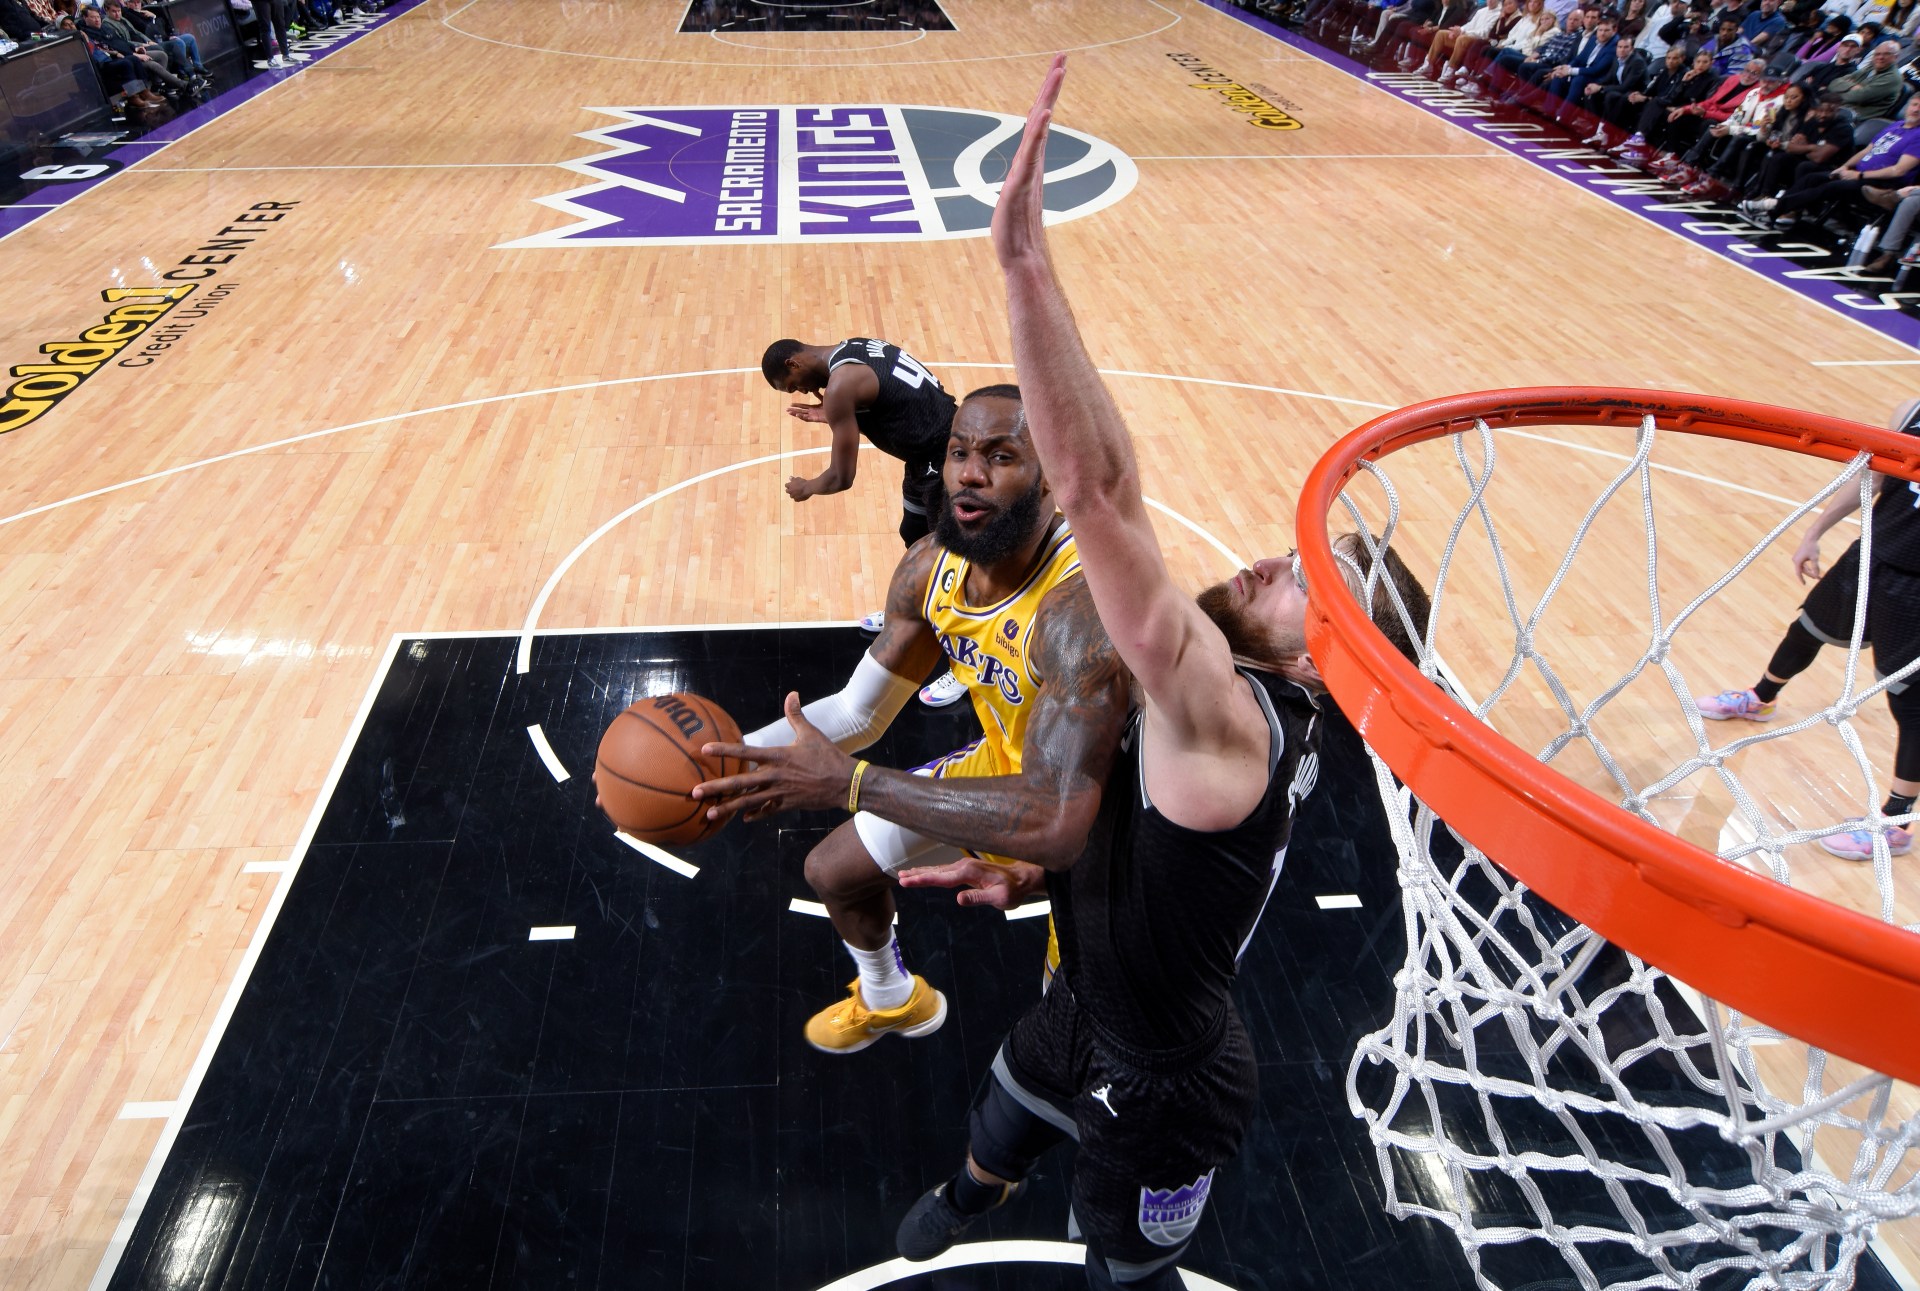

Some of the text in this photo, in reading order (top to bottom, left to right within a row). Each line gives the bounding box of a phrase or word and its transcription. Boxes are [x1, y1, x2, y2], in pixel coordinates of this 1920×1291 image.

[197, 14, 229, 37] TOYOTA
[1166, 52, 1233, 83] CENTER
[1365, 72, 1494, 118] PROUD
[19, 164, 110, 180] 6
[714, 110, 768, 231] SACRAMENTO
[796, 107, 922, 235] KINGS
[163, 200, 301, 281] CENTER
[118, 283, 240, 368] Credit Union
[943, 570, 955, 592] 6
[932, 621, 1024, 706] AKRS
[995, 633, 1020, 658] bibigo
